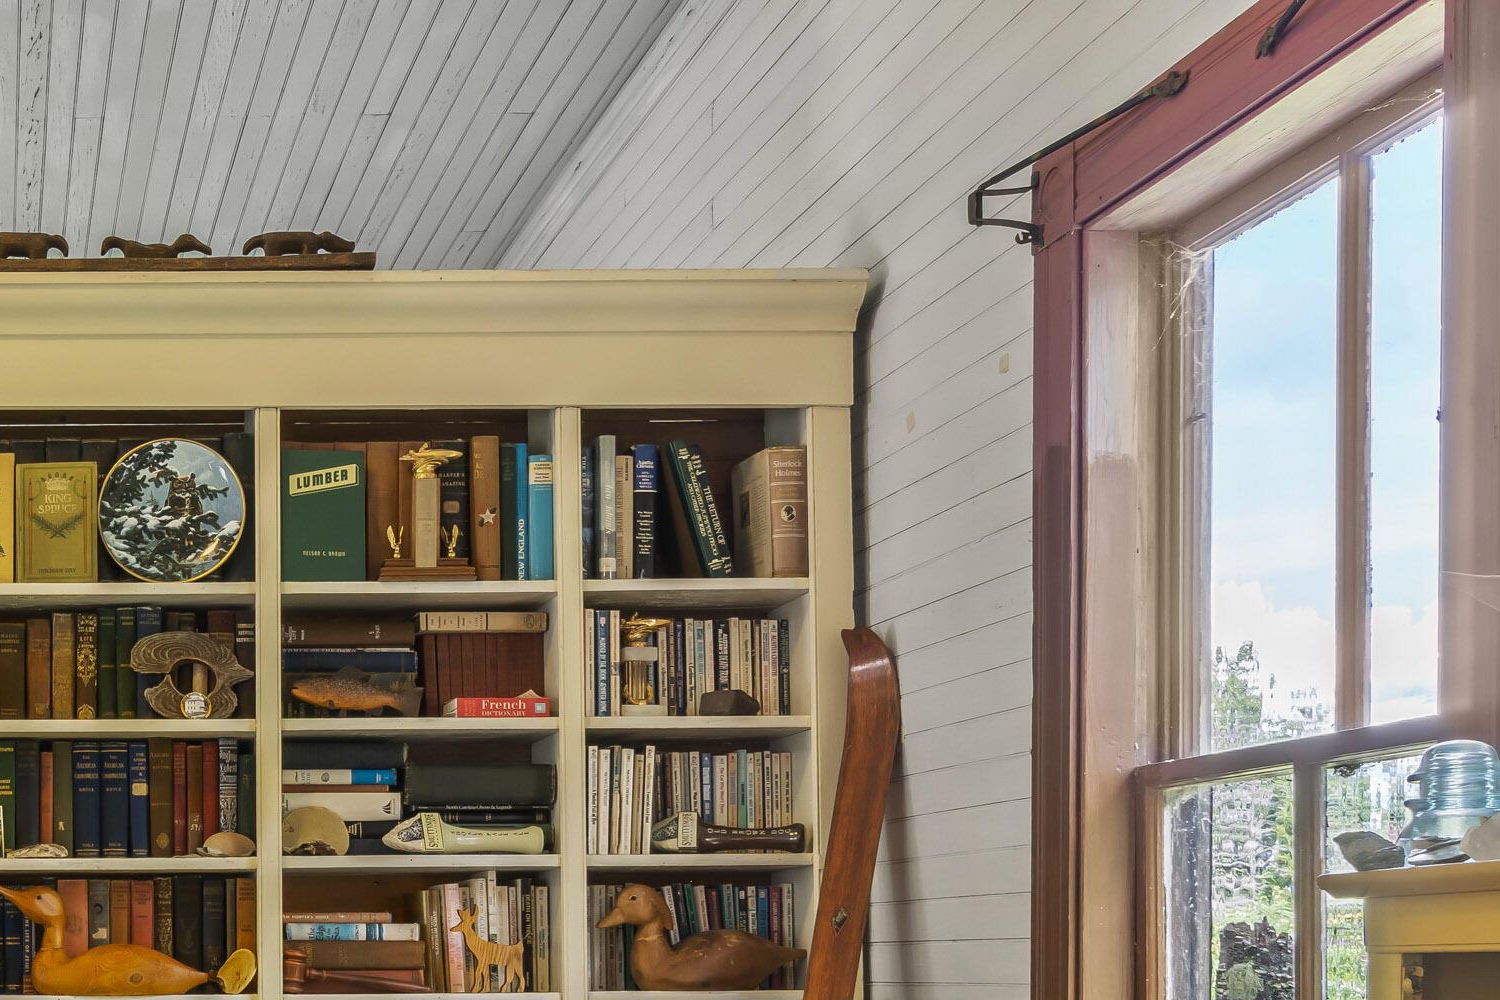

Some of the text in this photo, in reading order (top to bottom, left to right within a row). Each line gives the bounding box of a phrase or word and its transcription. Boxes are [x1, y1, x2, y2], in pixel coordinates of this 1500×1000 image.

[773, 460, 802, 468] Sherlock
[775, 469, 801, 477] Holmes
[296, 469, 349, 489] LUMBER
[44, 494, 71, 502] KING
[38, 504, 77, 514] SPRUCE
[703, 486, 725, 544] THE RETURN OF
[481, 699, 526, 710] French
